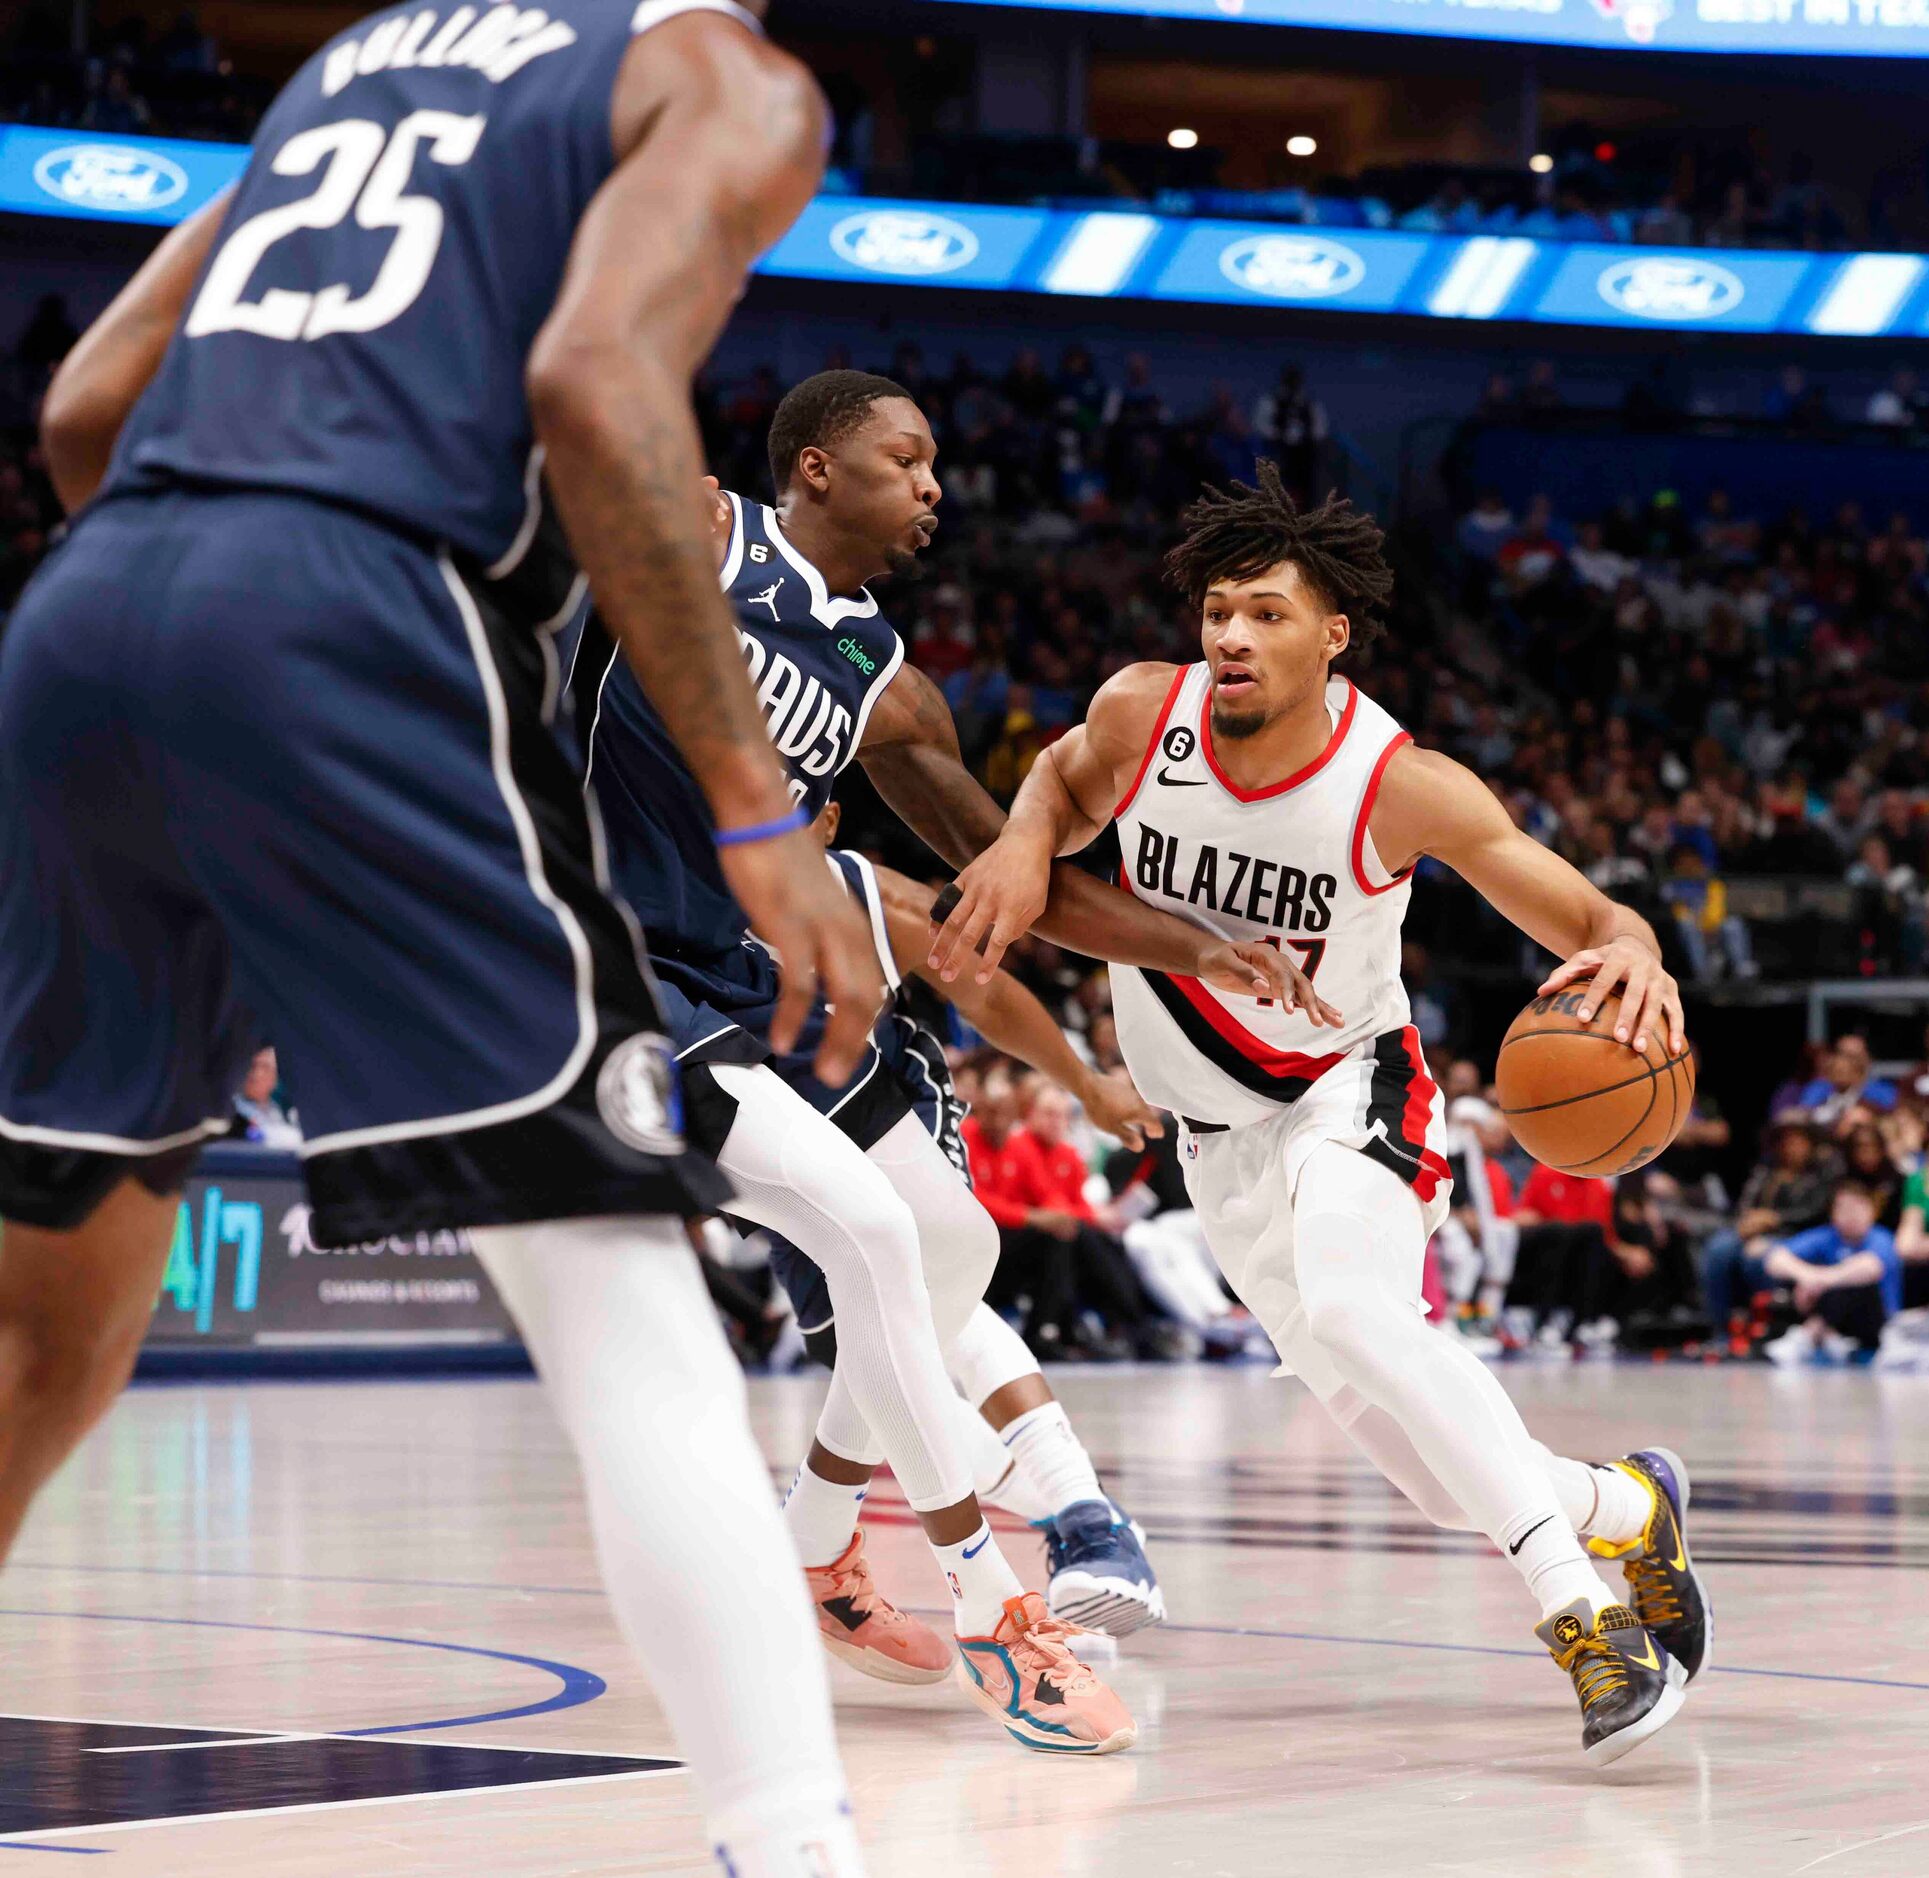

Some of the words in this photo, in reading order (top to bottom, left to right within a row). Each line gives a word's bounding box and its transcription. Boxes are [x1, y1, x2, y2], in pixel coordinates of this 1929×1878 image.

[186, 108, 487, 341] 25
[749, 543, 769, 564] 6
[837, 635, 876, 676] chime
[1169, 731, 1190, 759] 6
[1136, 820, 1338, 933] BLAZERS
